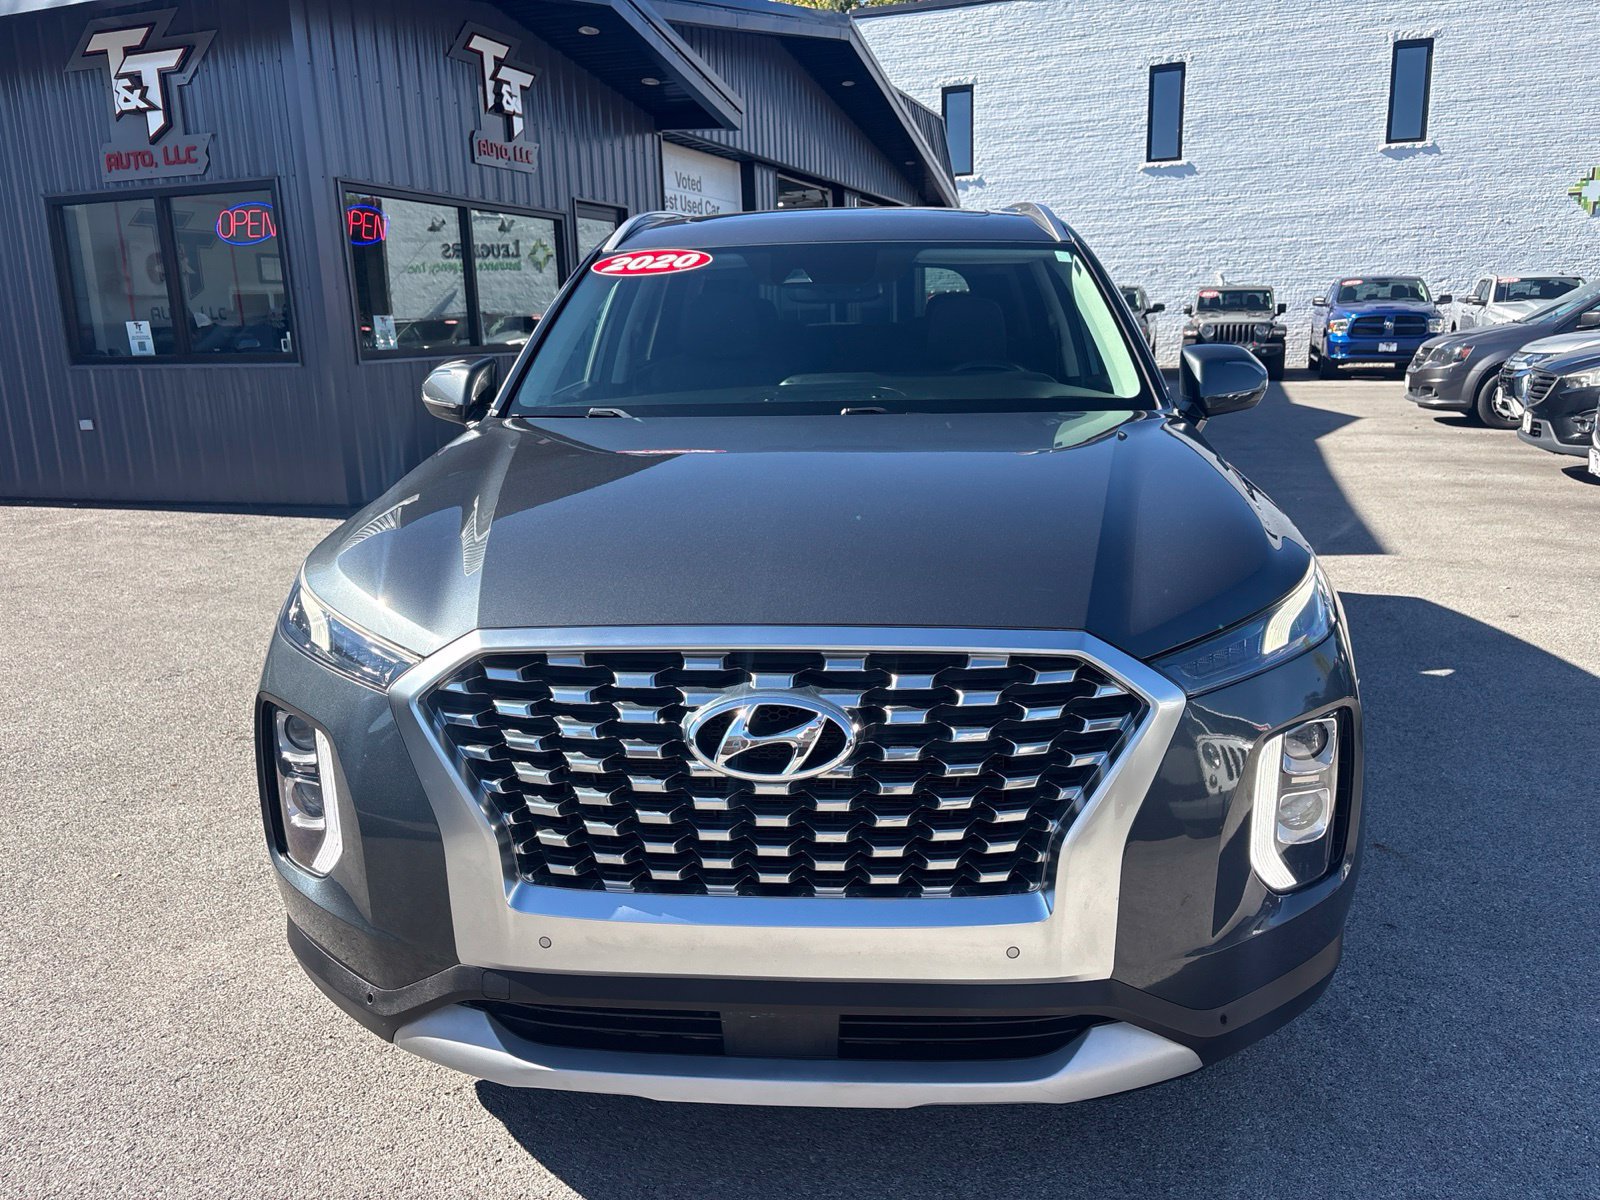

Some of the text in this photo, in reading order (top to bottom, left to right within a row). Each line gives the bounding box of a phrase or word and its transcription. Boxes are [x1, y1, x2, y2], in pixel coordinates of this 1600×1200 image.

[105, 145, 198, 173] AUTO, LLC
[478, 139, 534, 164] AUTO, LLC
[674, 171, 702, 193] Voted
[665, 194, 720, 215] est Used Car
[219, 208, 277, 239] OPEN
[347, 209, 387, 241] PEN
[601, 253, 701, 272] 2020
